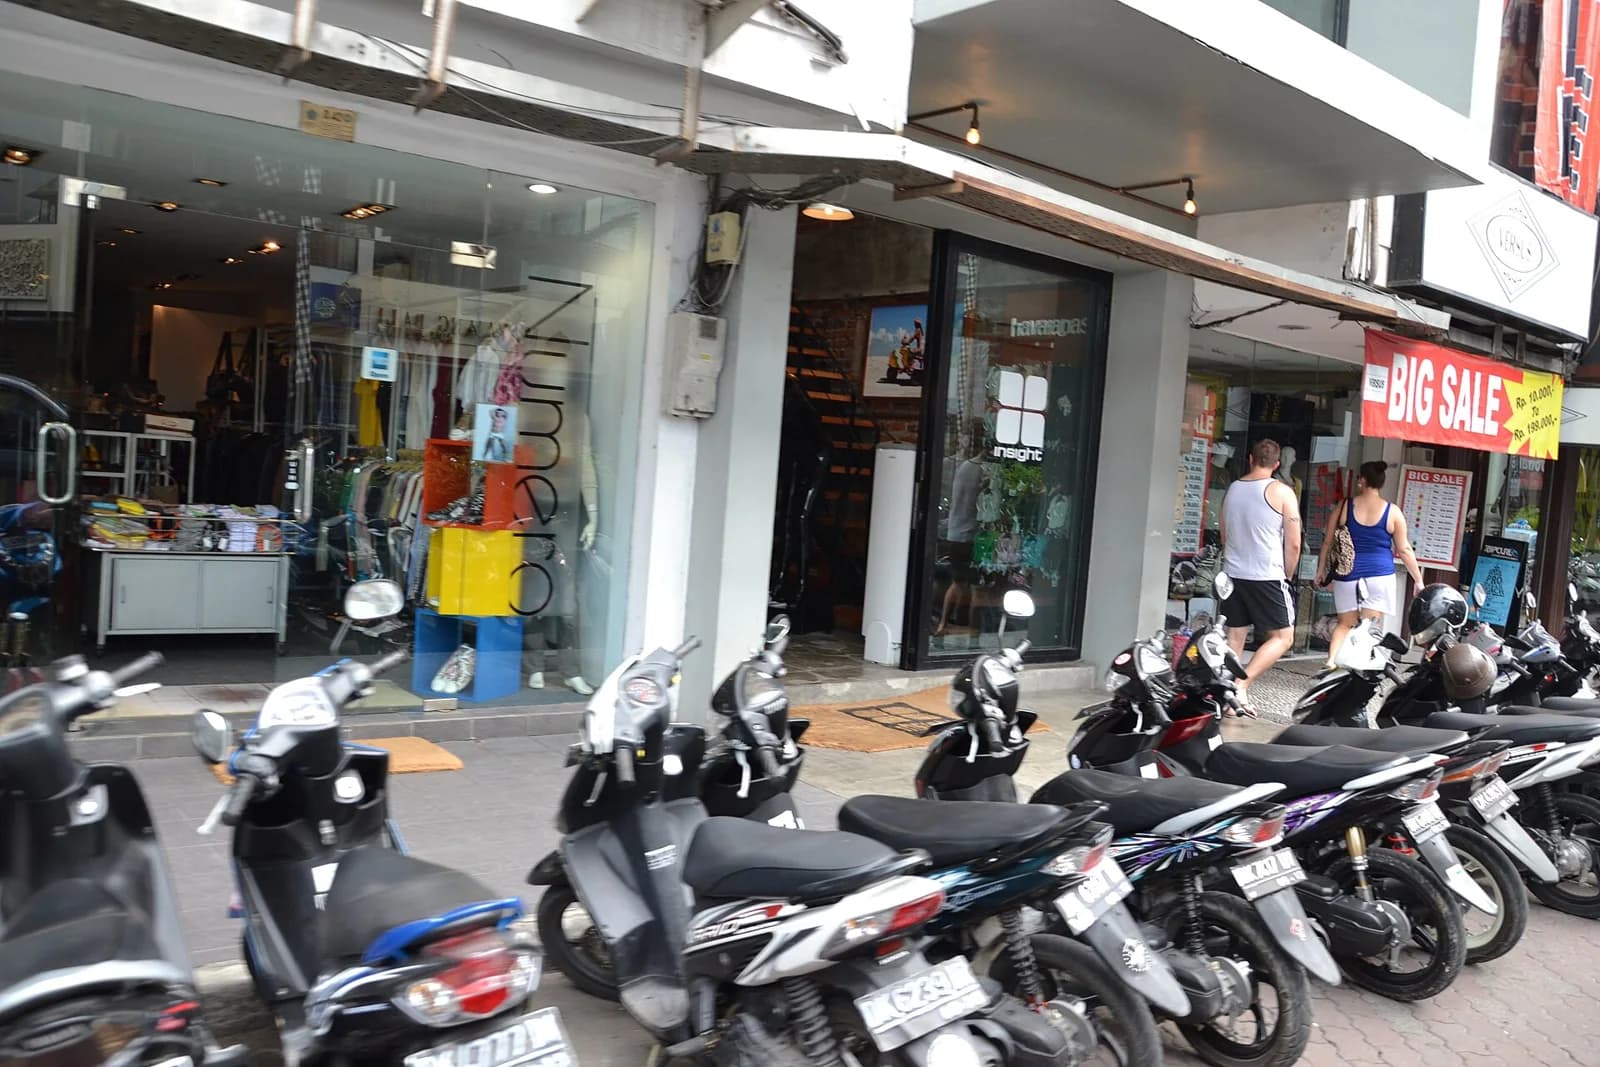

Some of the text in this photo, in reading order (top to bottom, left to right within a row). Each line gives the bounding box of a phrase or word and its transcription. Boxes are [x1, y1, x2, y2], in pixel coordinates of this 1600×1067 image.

[1388, 352, 1502, 436] BIG SALE
[993, 446, 1044, 462] insight
[1408, 471, 1465, 486] BIG SALE
